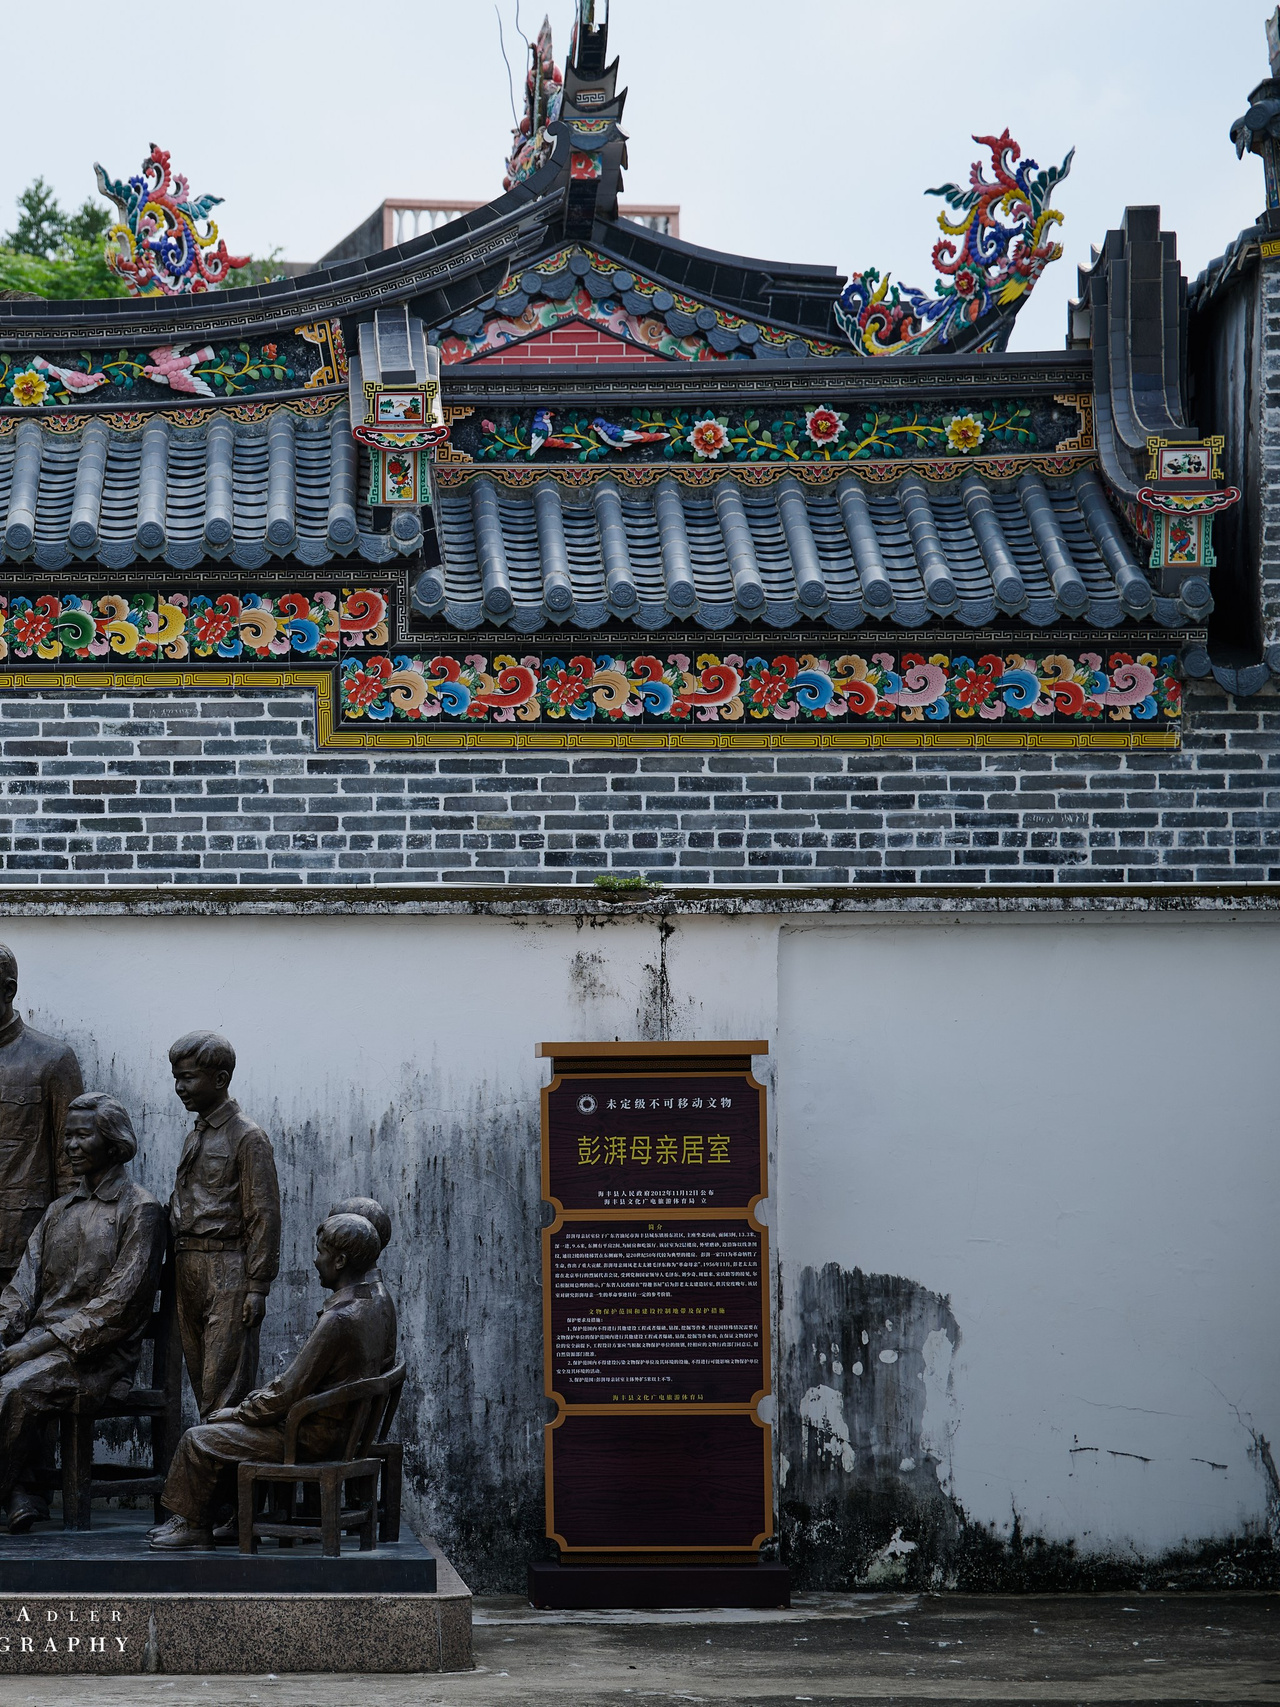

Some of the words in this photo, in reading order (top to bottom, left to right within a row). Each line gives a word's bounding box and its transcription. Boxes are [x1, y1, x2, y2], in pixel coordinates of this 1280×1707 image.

[606, 1097, 731, 1109] 未定级不可移动文物
[578, 1134, 730, 1165] 彭湃母亲居室
